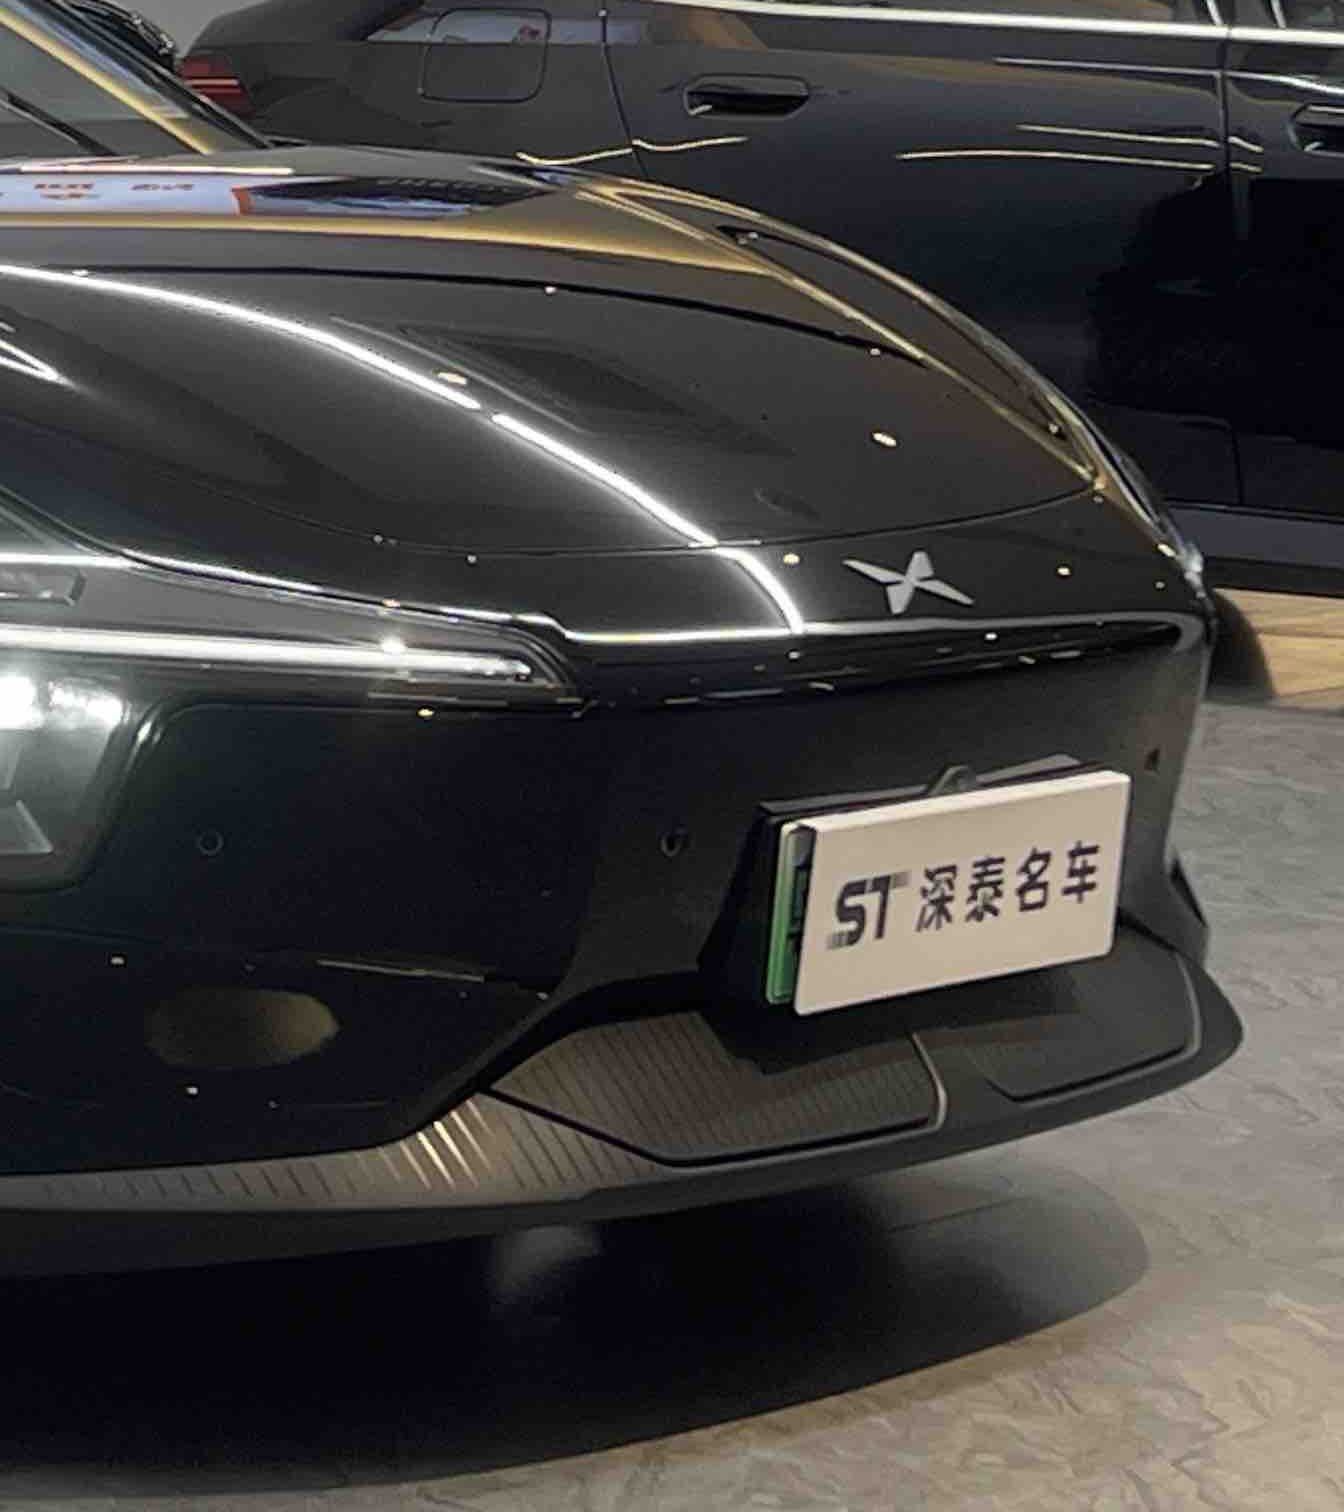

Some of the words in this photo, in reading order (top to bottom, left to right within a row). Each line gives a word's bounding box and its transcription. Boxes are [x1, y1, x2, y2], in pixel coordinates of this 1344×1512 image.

[826, 870, 912, 951] ST
[916, 840, 1101, 933] 深泰名车
